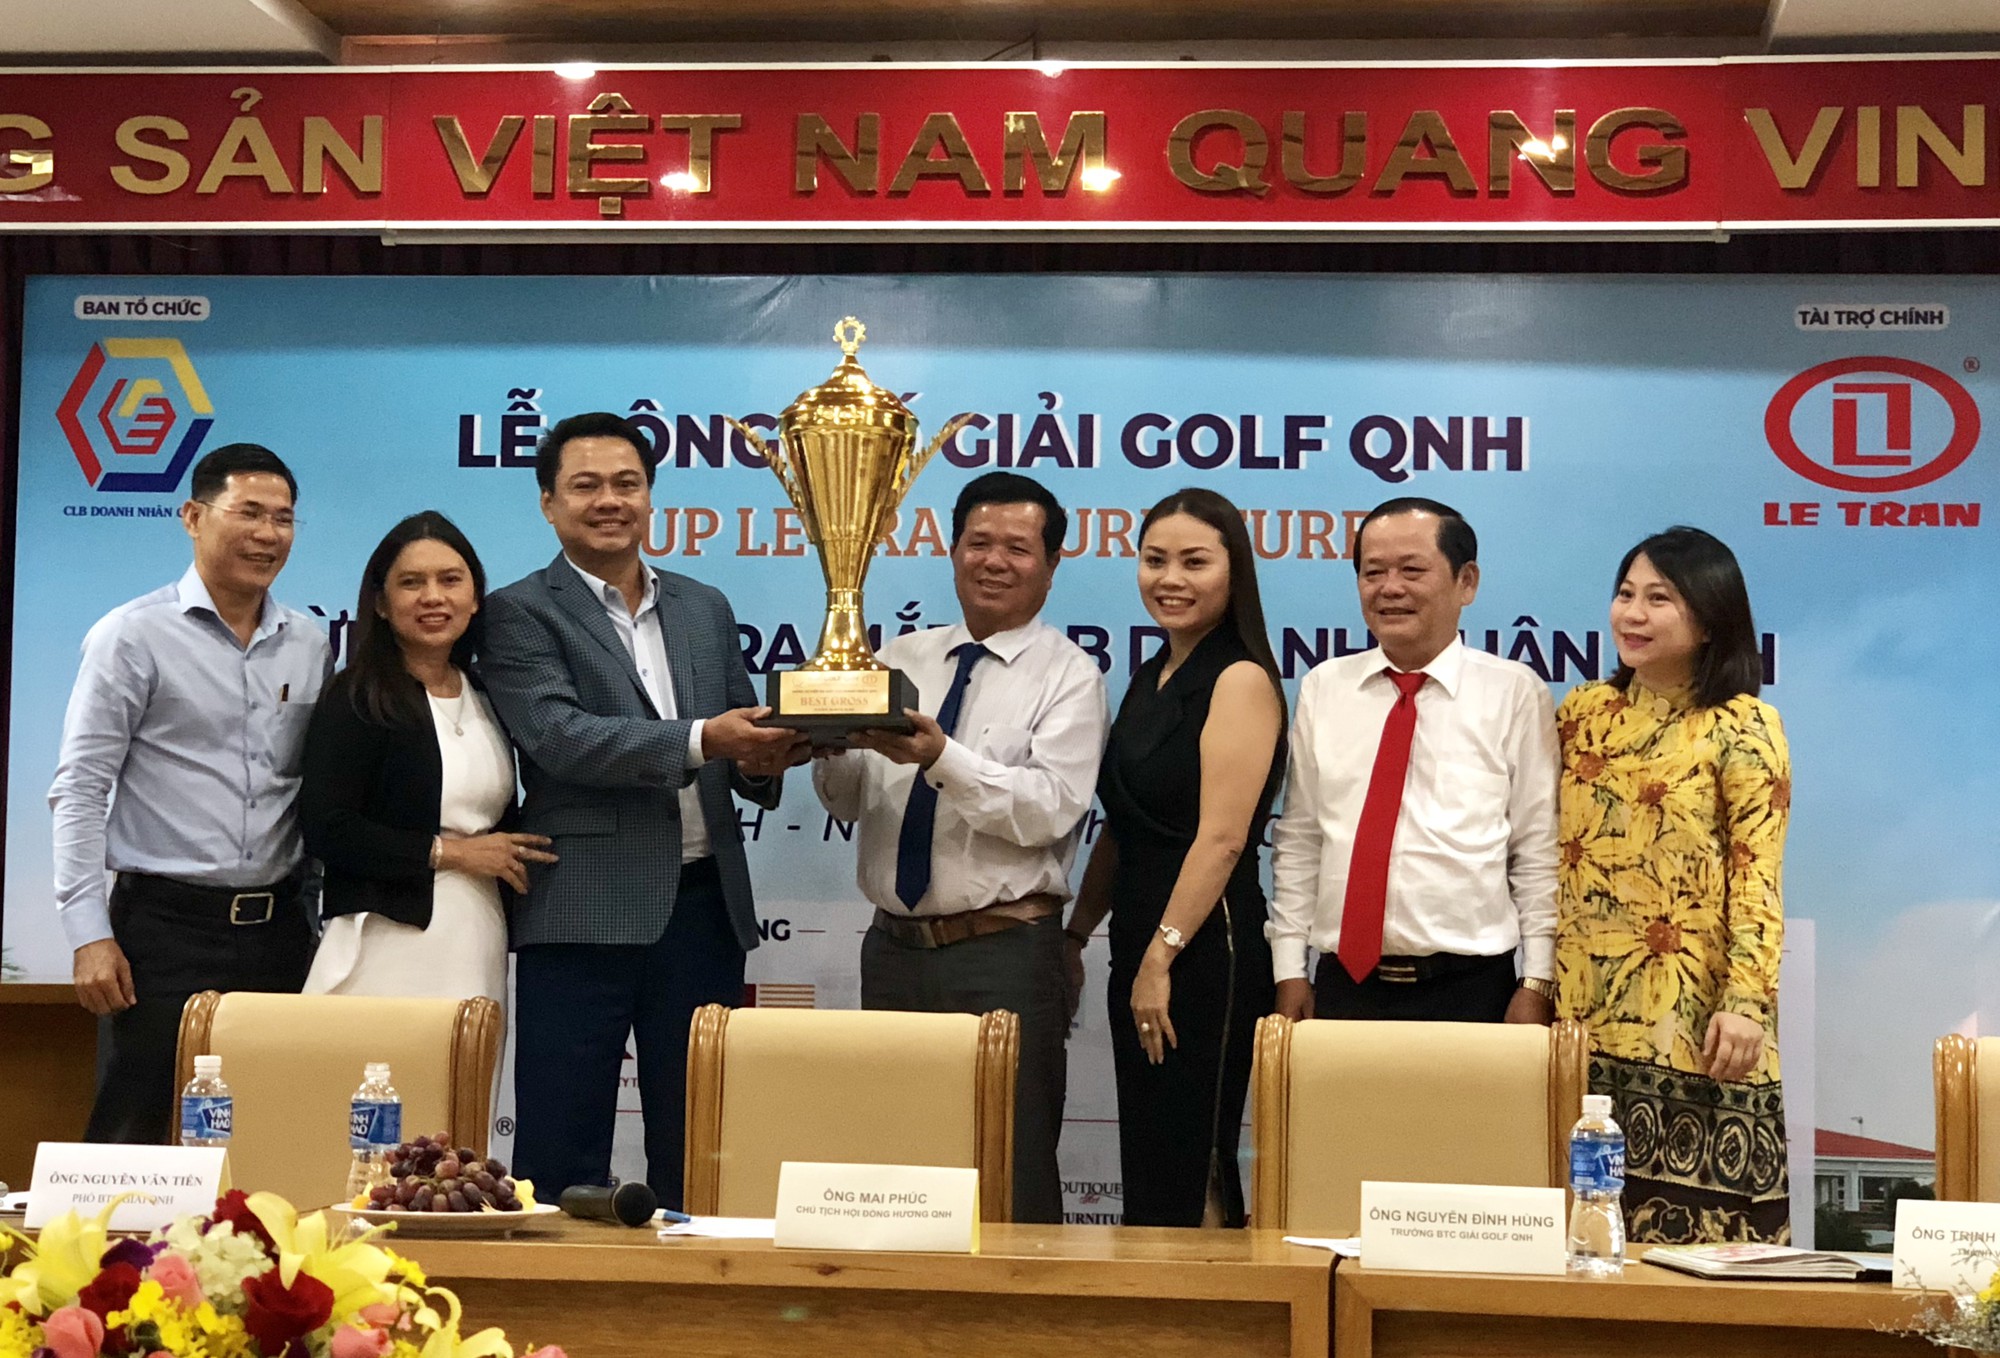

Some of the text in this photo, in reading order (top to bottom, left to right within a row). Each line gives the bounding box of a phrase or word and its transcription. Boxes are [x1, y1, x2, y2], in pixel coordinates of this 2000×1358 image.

[109, 86, 383, 195] SẢN
[432, 92, 741, 214] VIỆT
[796, 111, 1105, 192] NAM
[1167, 107, 1688, 196] QUANG
[83, 297, 202, 316] BAN TỔ CHỨC
[1798, 307, 1944, 329] TÀI TRỢ CHÍNH
[625, 399, 780, 468] ÔNG
[942, 392, 1094, 469] GIẢI
[1120, 413, 1326, 470] GOLF
[1349, 414, 1525, 484] QNH
[63, 505, 87, 516] CLB
[90, 506, 134, 517] DOANH
[137, 504, 172, 517] NHÂN
[1763, 501, 1980, 527] LE TRAN
[641, 508, 720, 557] UP
[800, 696, 828, 706] BEST
[49, 1171, 78, 1184] ÔNG
[823, 1188, 928, 1205] ÔNG MAI PHÚC
[892, 1210, 929, 1218] HƯƠNG
[931, 1210, 952, 1218] QNH
[1369, 1207, 1555, 1228] ÔNG NGUYỄN ĐÌNH HÙNG
[1436, 1230, 1456, 1239] BTC
[1481, 1232, 1509, 1241] GOLF
[1511, 1232, 1534, 1242] QNH
[1912, 1226, 1945, 1241] ÔNG
